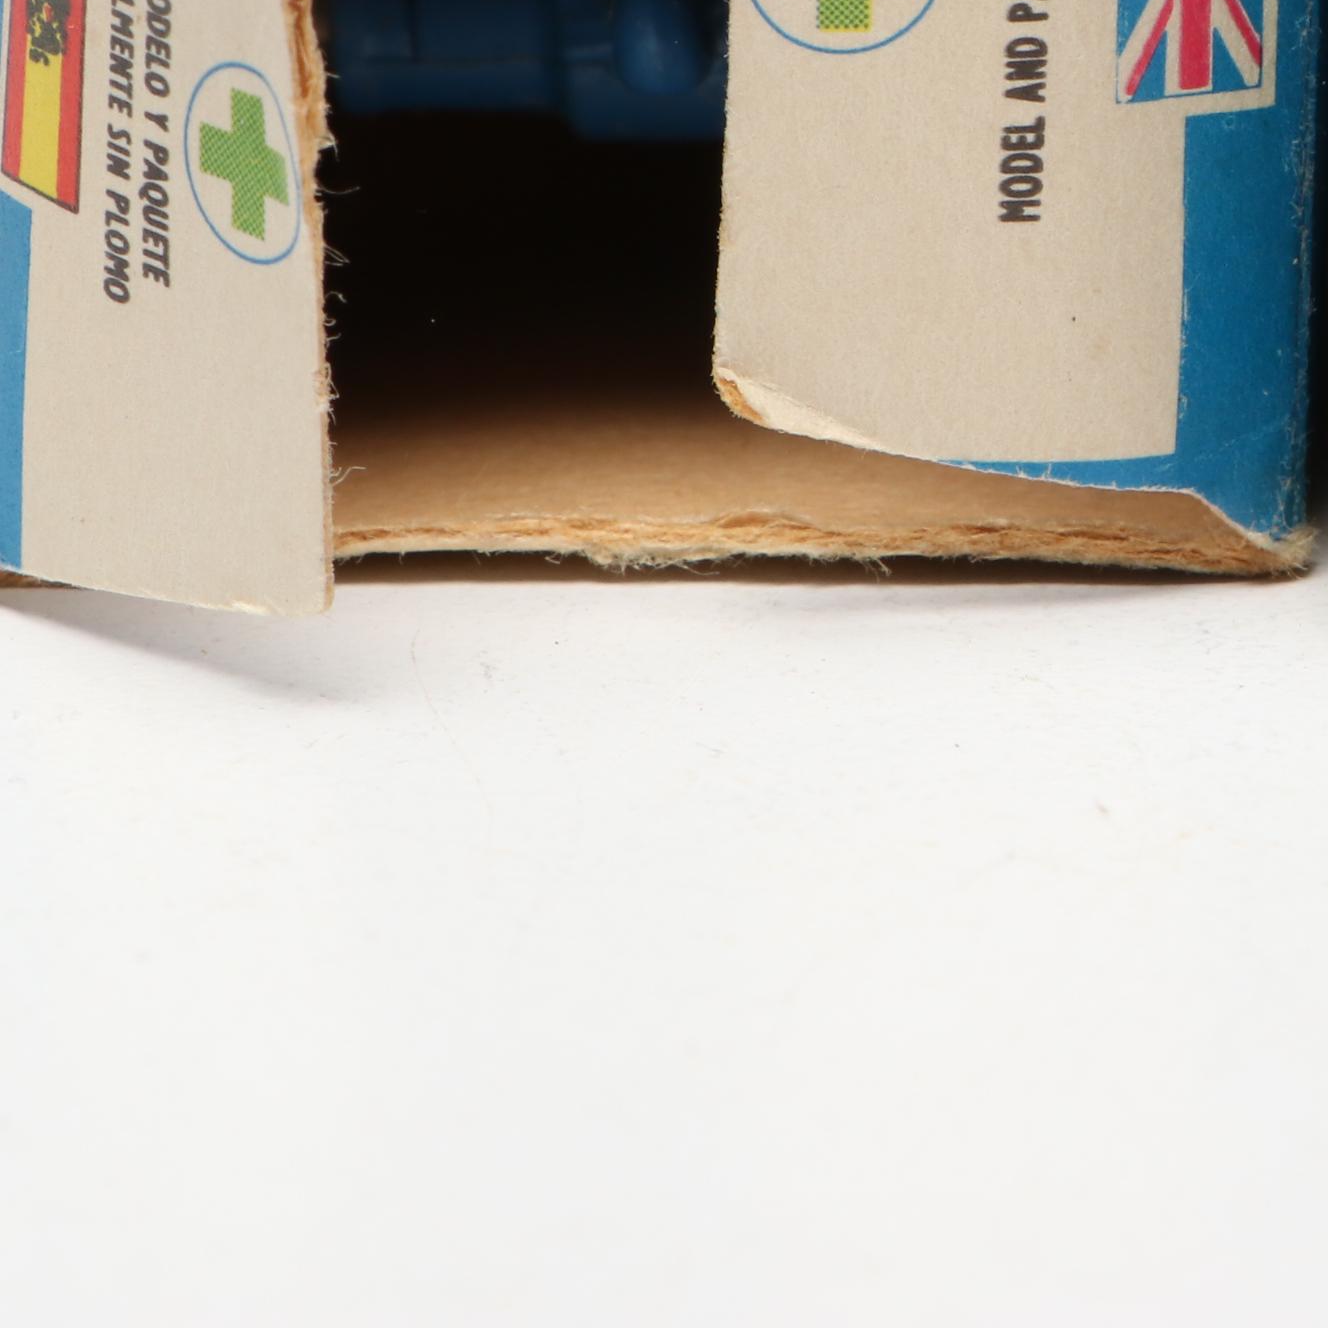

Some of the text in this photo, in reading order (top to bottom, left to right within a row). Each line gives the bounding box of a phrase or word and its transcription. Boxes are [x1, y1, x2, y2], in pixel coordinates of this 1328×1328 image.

[1004, 36, 1049, 104] AND
[107, 124, 134, 181] SIN
[144, 110, 169, 132] Y
[998, 114, 1046, 223] MODEL
[103, 188, 131, 305] PLOMO
[138, 138, 171, 288] PAQUETE
